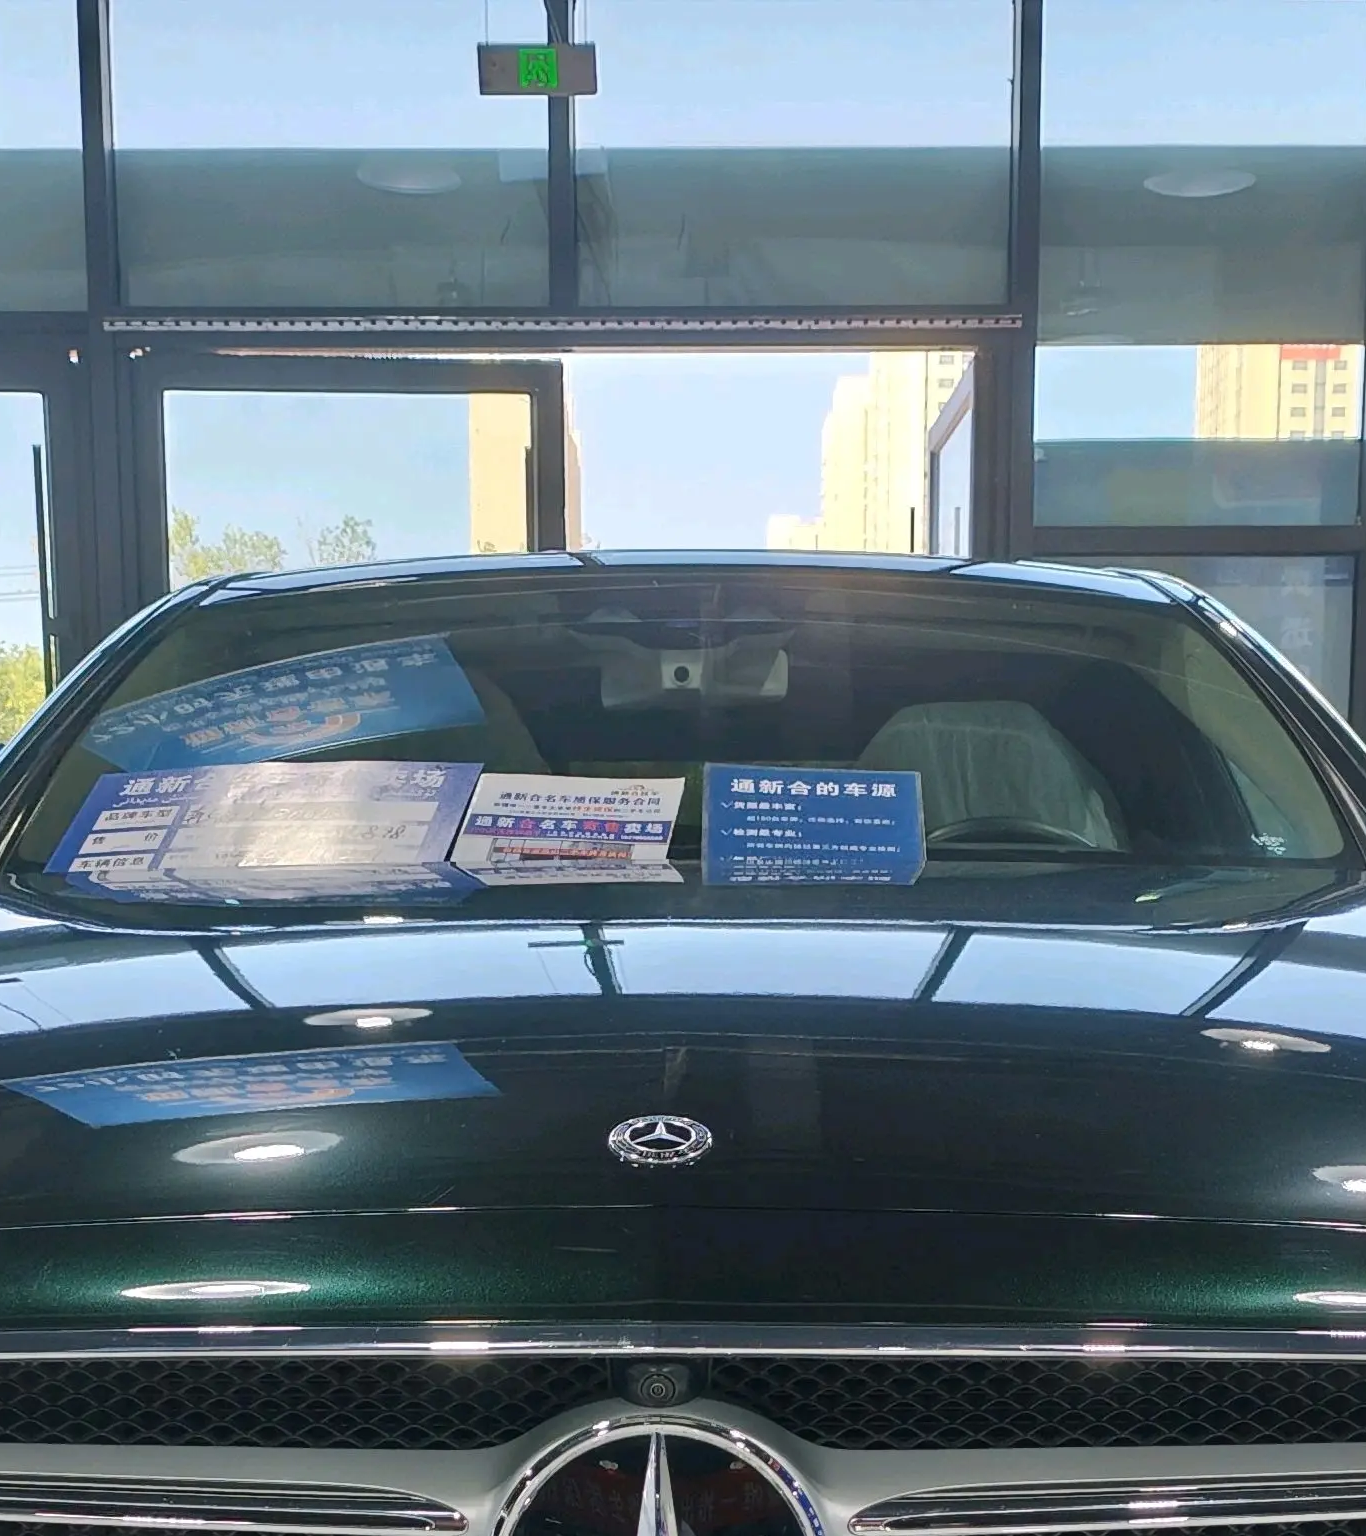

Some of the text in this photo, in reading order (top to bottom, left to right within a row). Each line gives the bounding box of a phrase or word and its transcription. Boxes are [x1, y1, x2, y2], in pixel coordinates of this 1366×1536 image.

[731, 778, 897, 798] 通新合的车源
